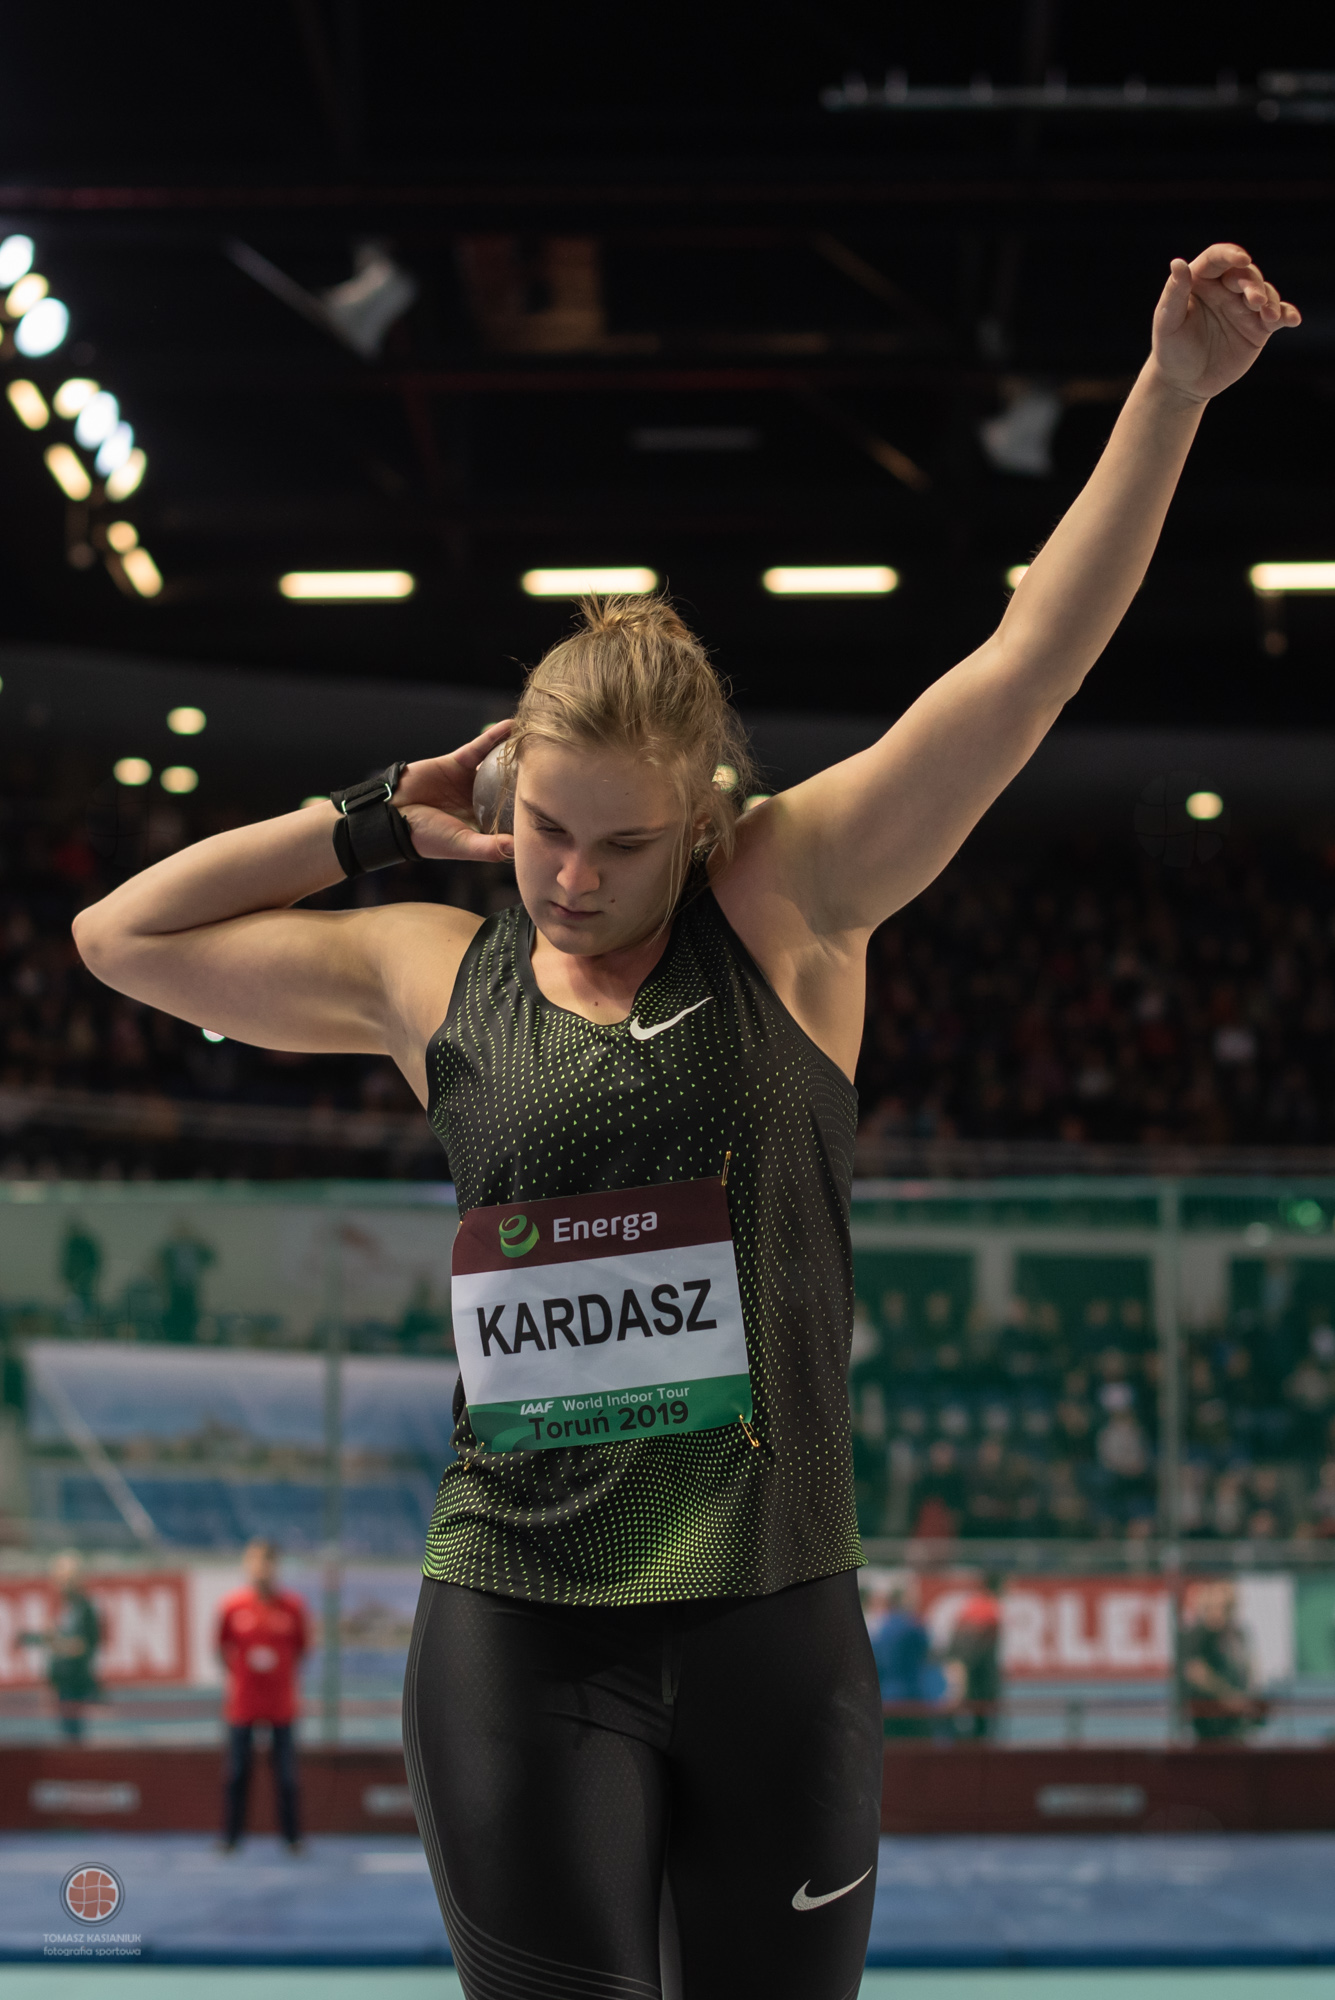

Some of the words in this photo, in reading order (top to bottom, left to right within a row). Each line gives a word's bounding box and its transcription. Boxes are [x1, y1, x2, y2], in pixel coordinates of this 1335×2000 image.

[553, 1211, 658, 1243] Energa
[476, 1278, 718, 1357] KARDASZ
[520, 1400, 554, 1415] IAAF
[562, 1395, 603, 1412] World
[607, 1391, 654, 1407] Indoor
[657, 1385, 690, 1400] Tour
[528, 1406, 610, 1441] Toruń
[619, 1400, 689, 1431] 2019
